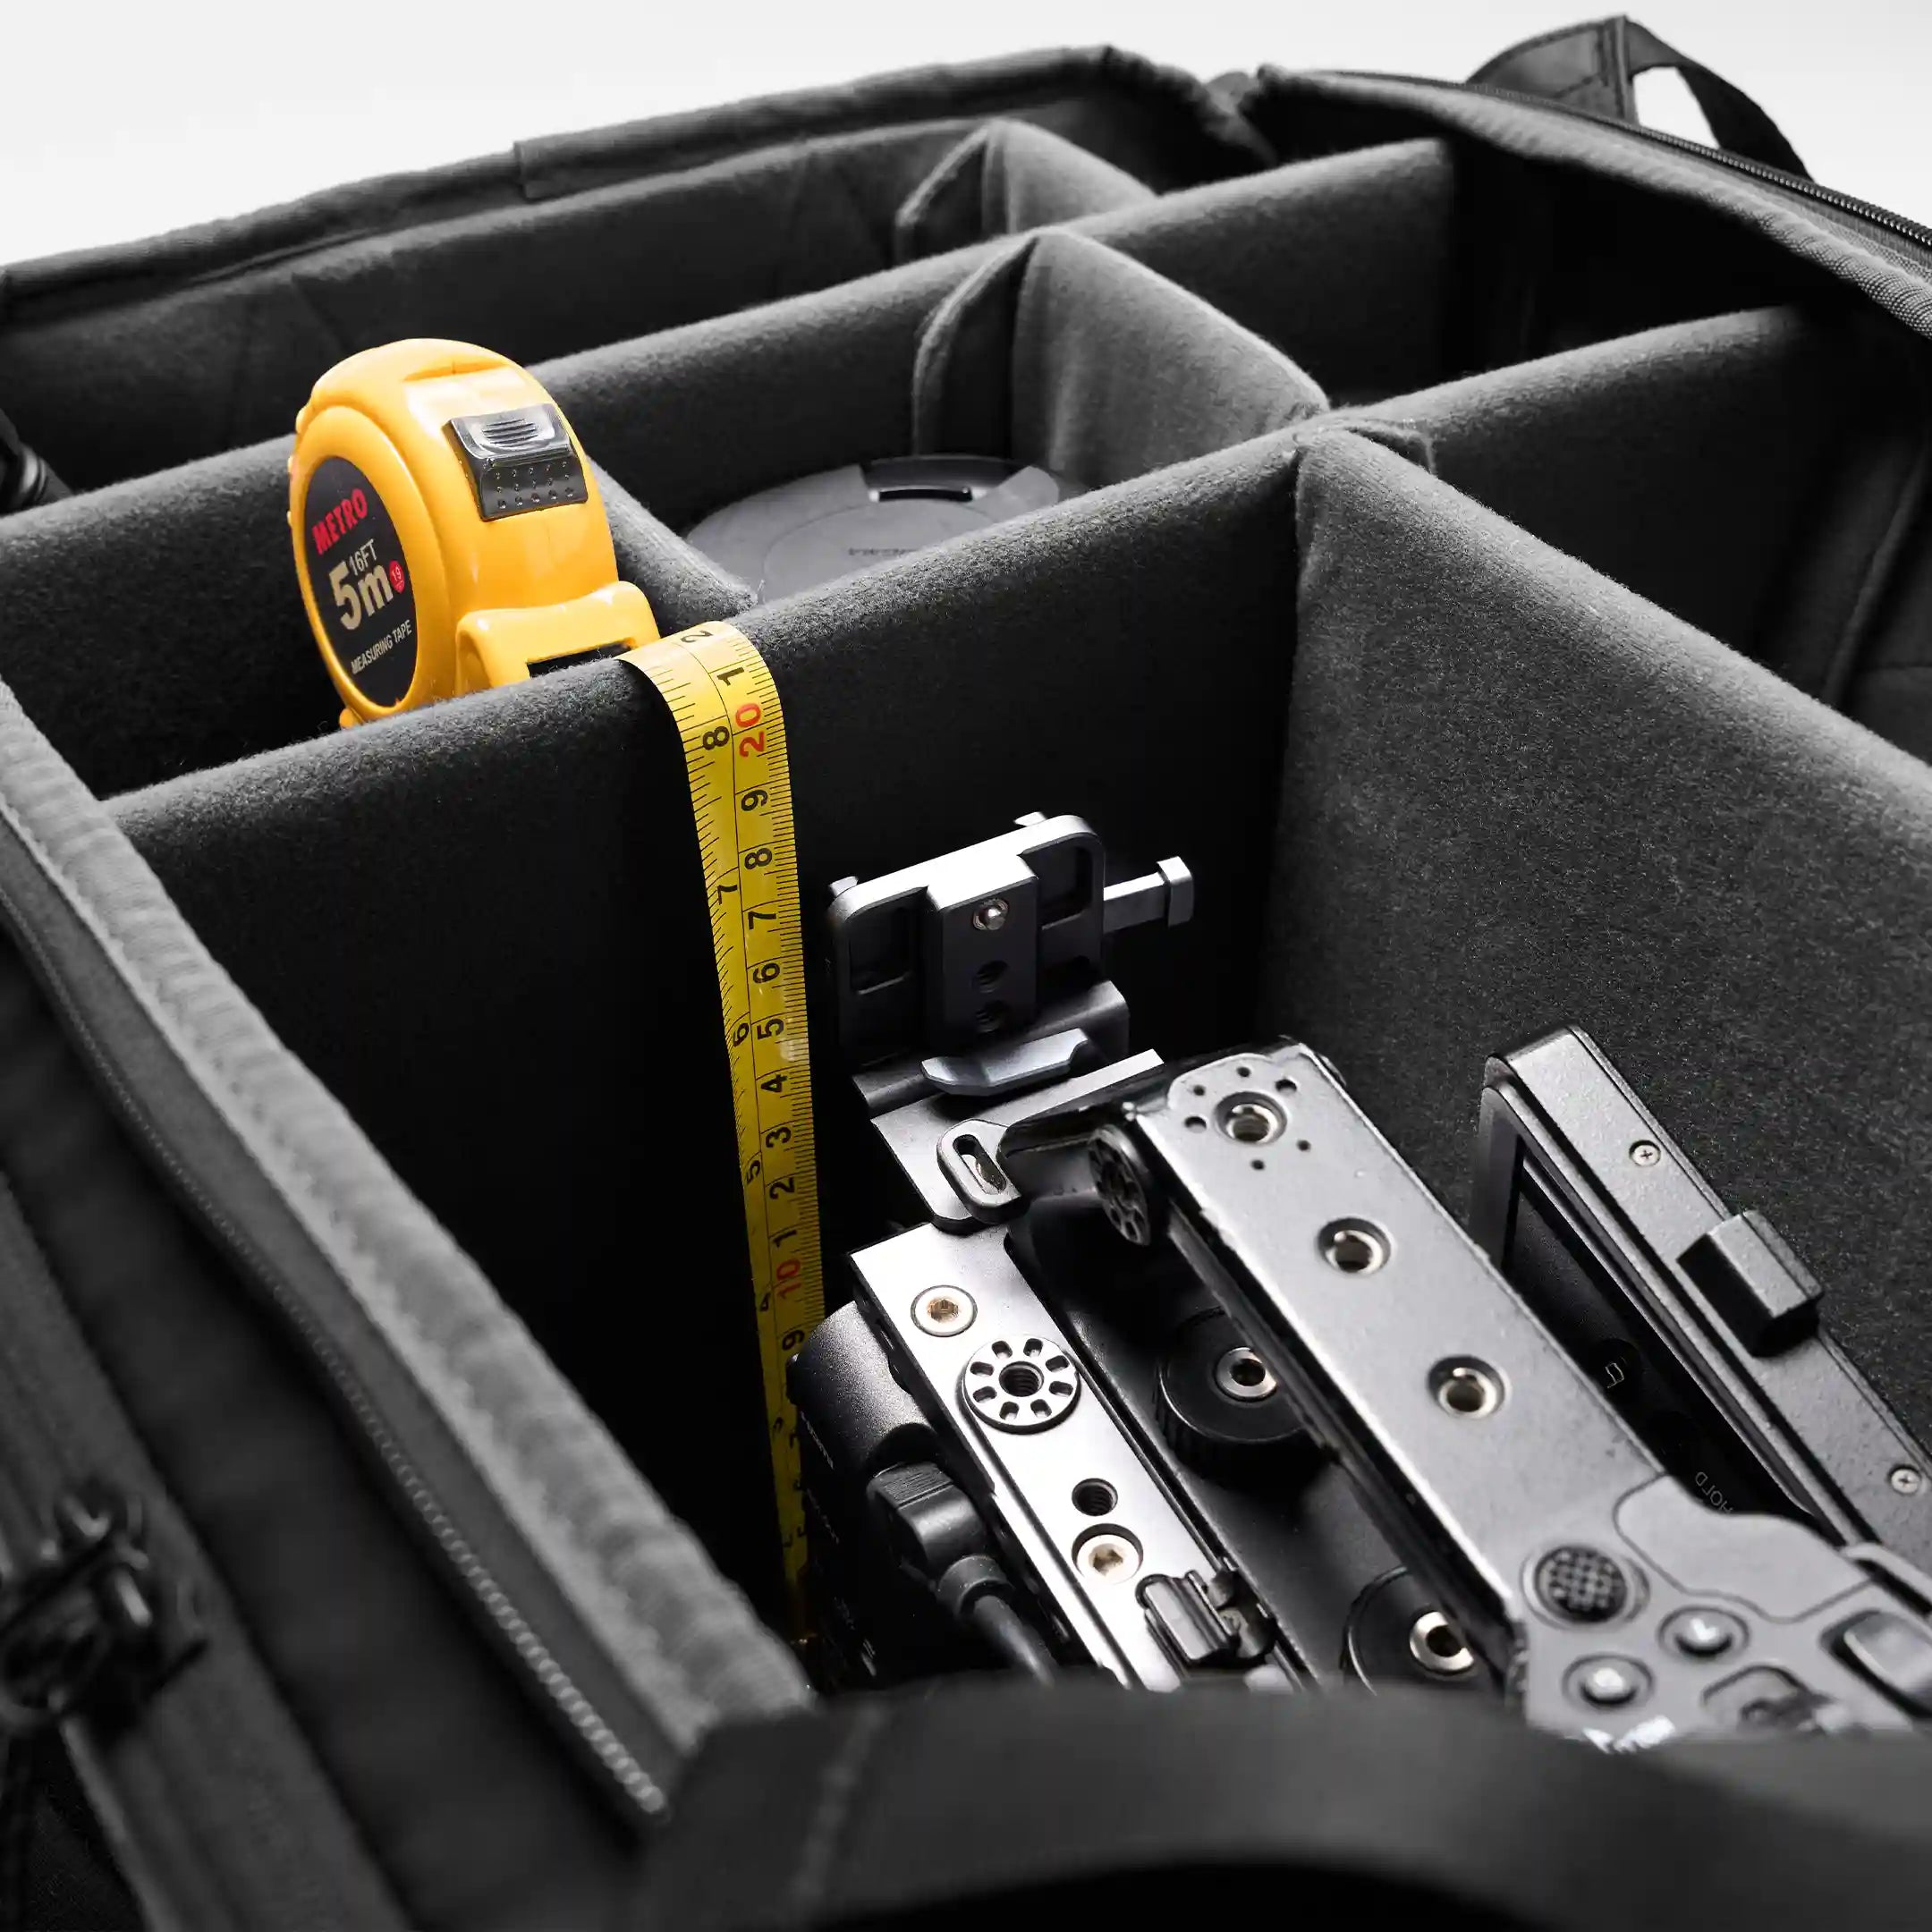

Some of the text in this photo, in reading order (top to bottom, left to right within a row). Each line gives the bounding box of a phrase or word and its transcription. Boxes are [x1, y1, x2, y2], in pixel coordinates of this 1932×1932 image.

[312, 488, 368, 555] METRO
[348, 538, 377, 576] 16FT
[328, 561, 394, 631] 5m
[351, 619, 412, 674] MEASURING TAPE
[716, 666, 744, 686] 1
[702, 725, 730, 750] 8
[735, 703, 765, 758] 20
[741, 789, 768, 812] 9
[744, 847, 773, 870] 8
[716, 884, 738, 905] 7
[748, 911, 777, 930] 7
[752, 962, 780, 984] 6
[733, 1022, 750, 1047] 6
[756, 1018, 784, 1040] 5
[760, 1073, 788, 1093] 4
[765, 1126, 792, 1148] 3
[746, 1159, 760, 1184] 5
[769, 1177, 795, 1199] 2
[772, 1229, 798, 1248] 1
[776, 1258, 802, 1299] 10
[782, 1329, 805, 1352] 9
